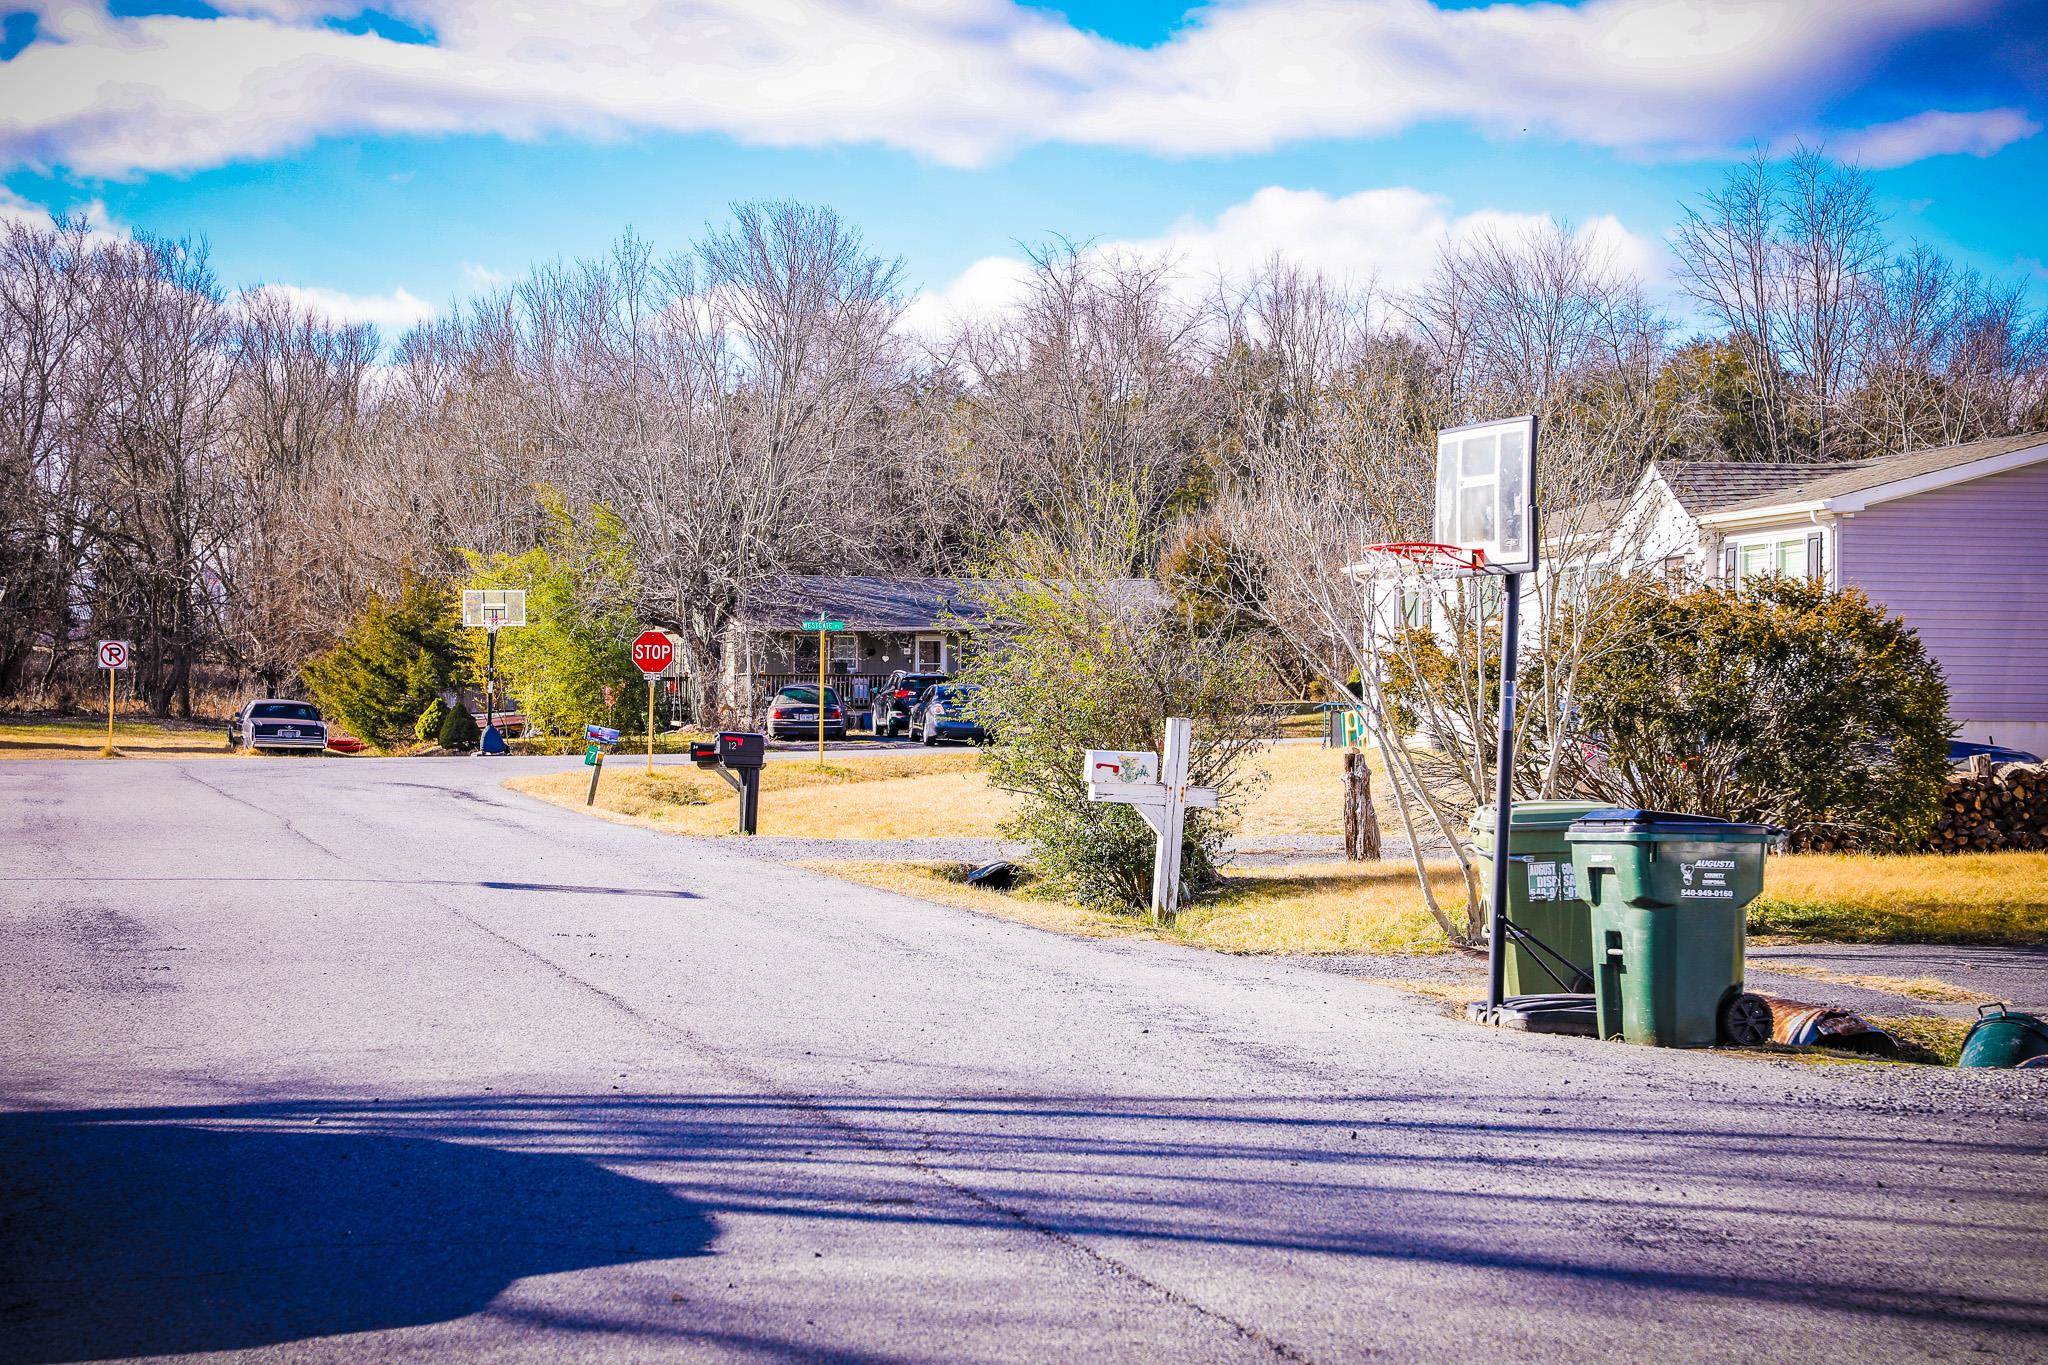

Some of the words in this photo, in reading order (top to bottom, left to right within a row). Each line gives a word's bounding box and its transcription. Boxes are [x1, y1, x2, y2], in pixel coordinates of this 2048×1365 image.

[635, 644, 670, 659] STOP
[729, 741, 737, 750] 12
[589, 751, 596, 760] 7
[1695, 860, 1734, 868] AUGUSTA
[1529, 864, 1556, 876] AUGUST
[1537, 875, 1575, 888] DISPSA
[1681, 889, 1733, 897] 540-949-0160
